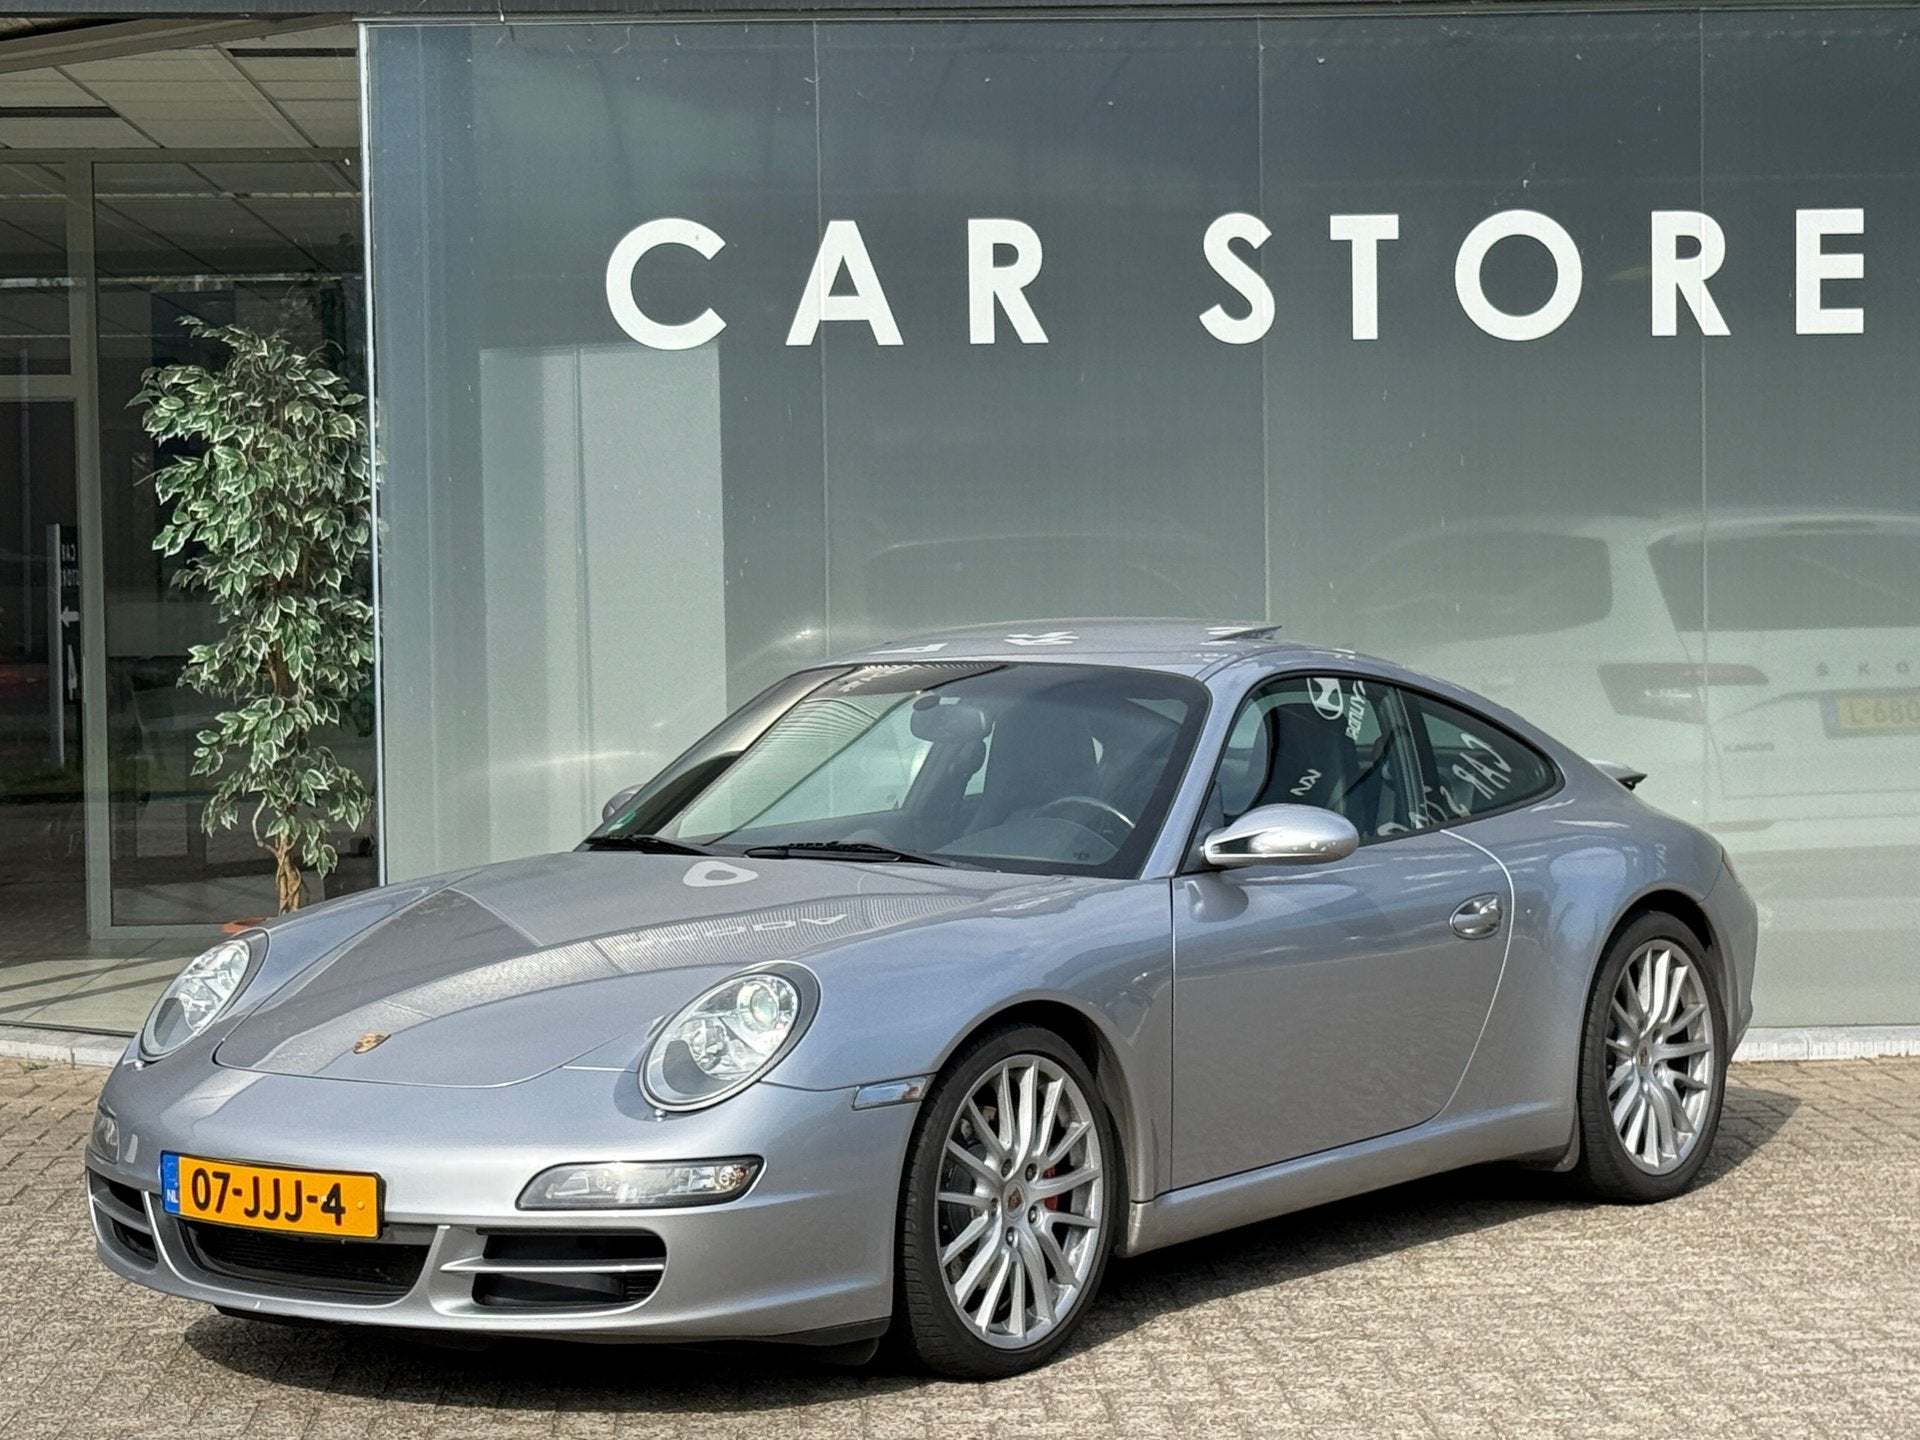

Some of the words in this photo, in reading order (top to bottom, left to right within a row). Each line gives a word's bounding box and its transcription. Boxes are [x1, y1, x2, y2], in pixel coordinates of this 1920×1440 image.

[605, 217, 1049, 350] CAR
[1198, 208, 1866, 344] STORE
[190, 1167, 347, 1226] 07-JJJ-4
